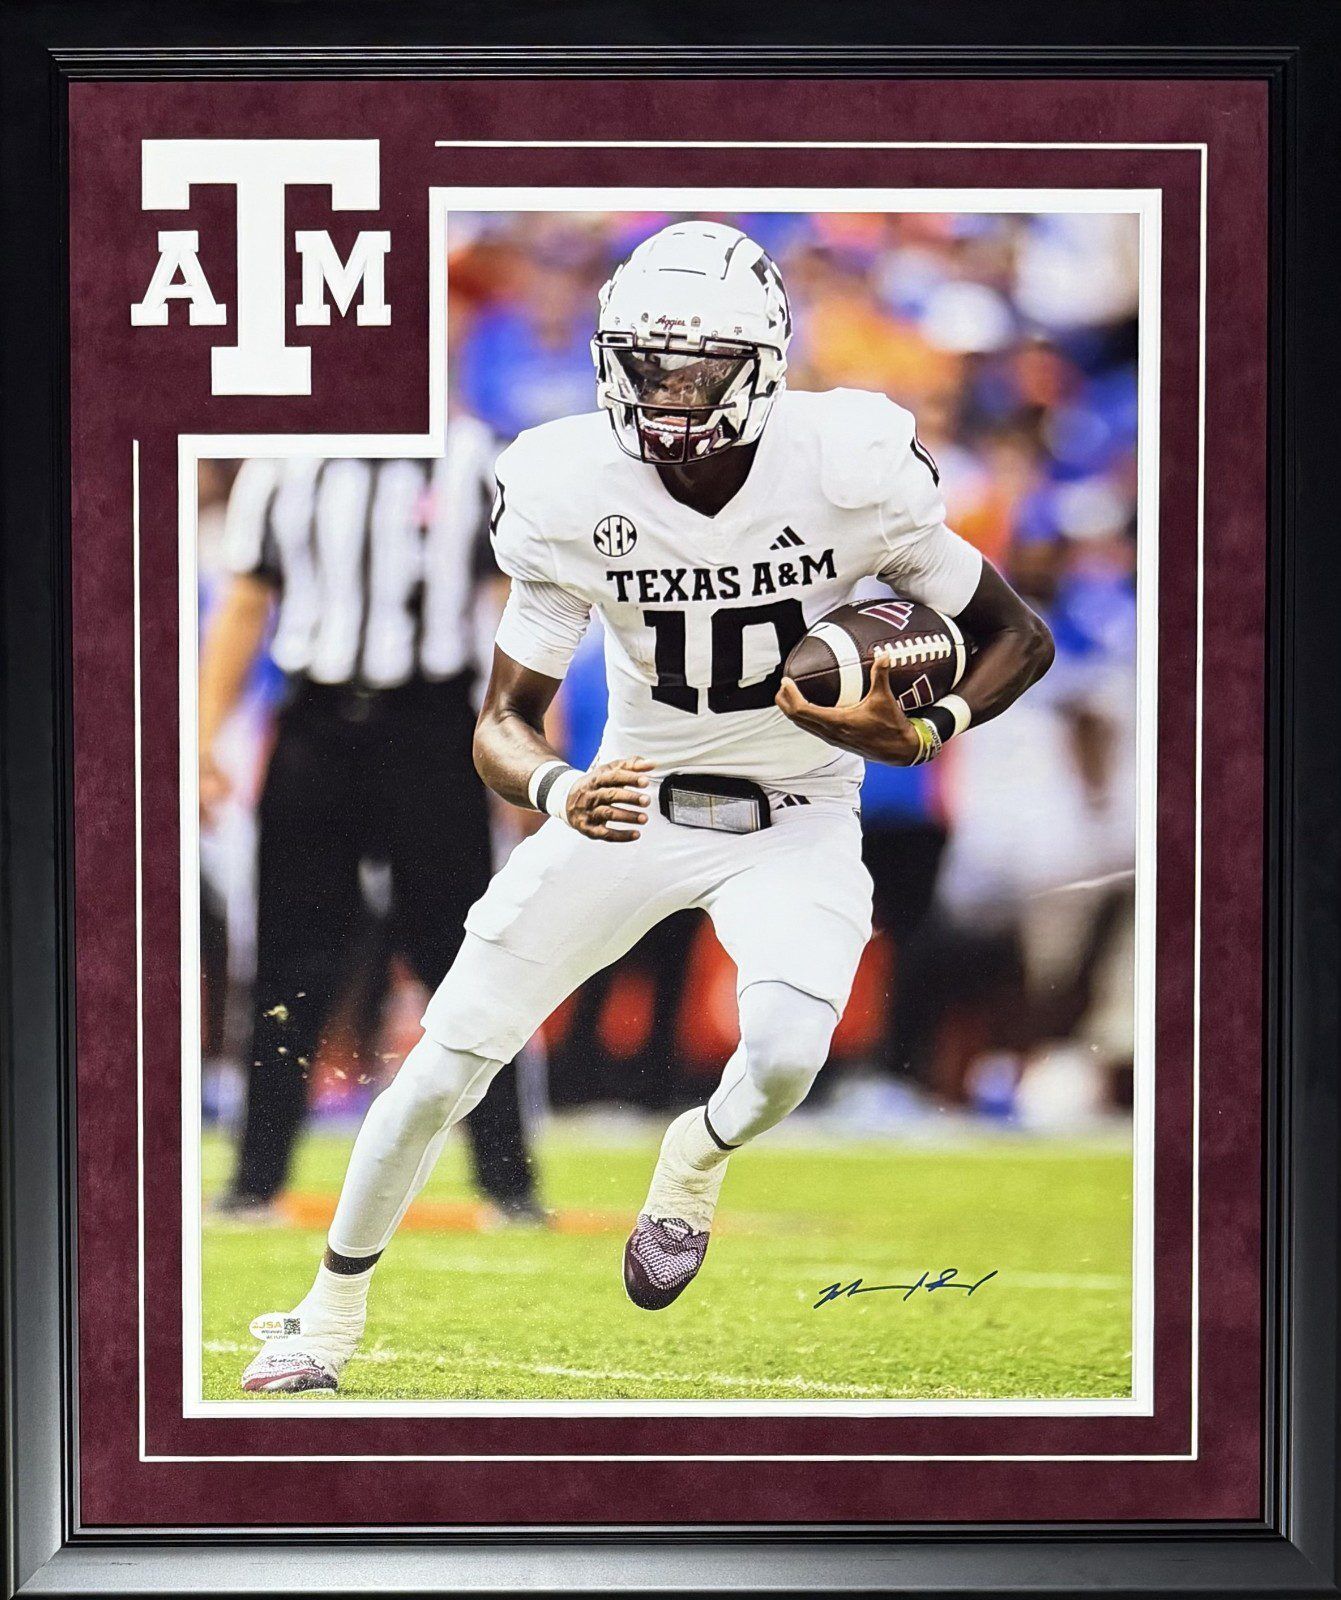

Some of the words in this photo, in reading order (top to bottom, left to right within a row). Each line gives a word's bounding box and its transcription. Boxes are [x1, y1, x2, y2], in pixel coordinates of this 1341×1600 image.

[655, 314, 687, 330] Aggies
[593, 515, 637, 557] SEC
[607, 566, 741, 603] TEXAS
[752, 549, 837, 596] A&M
[643, 598, 808, 715] 10
[259, 1321, 282, 1329] JSA
